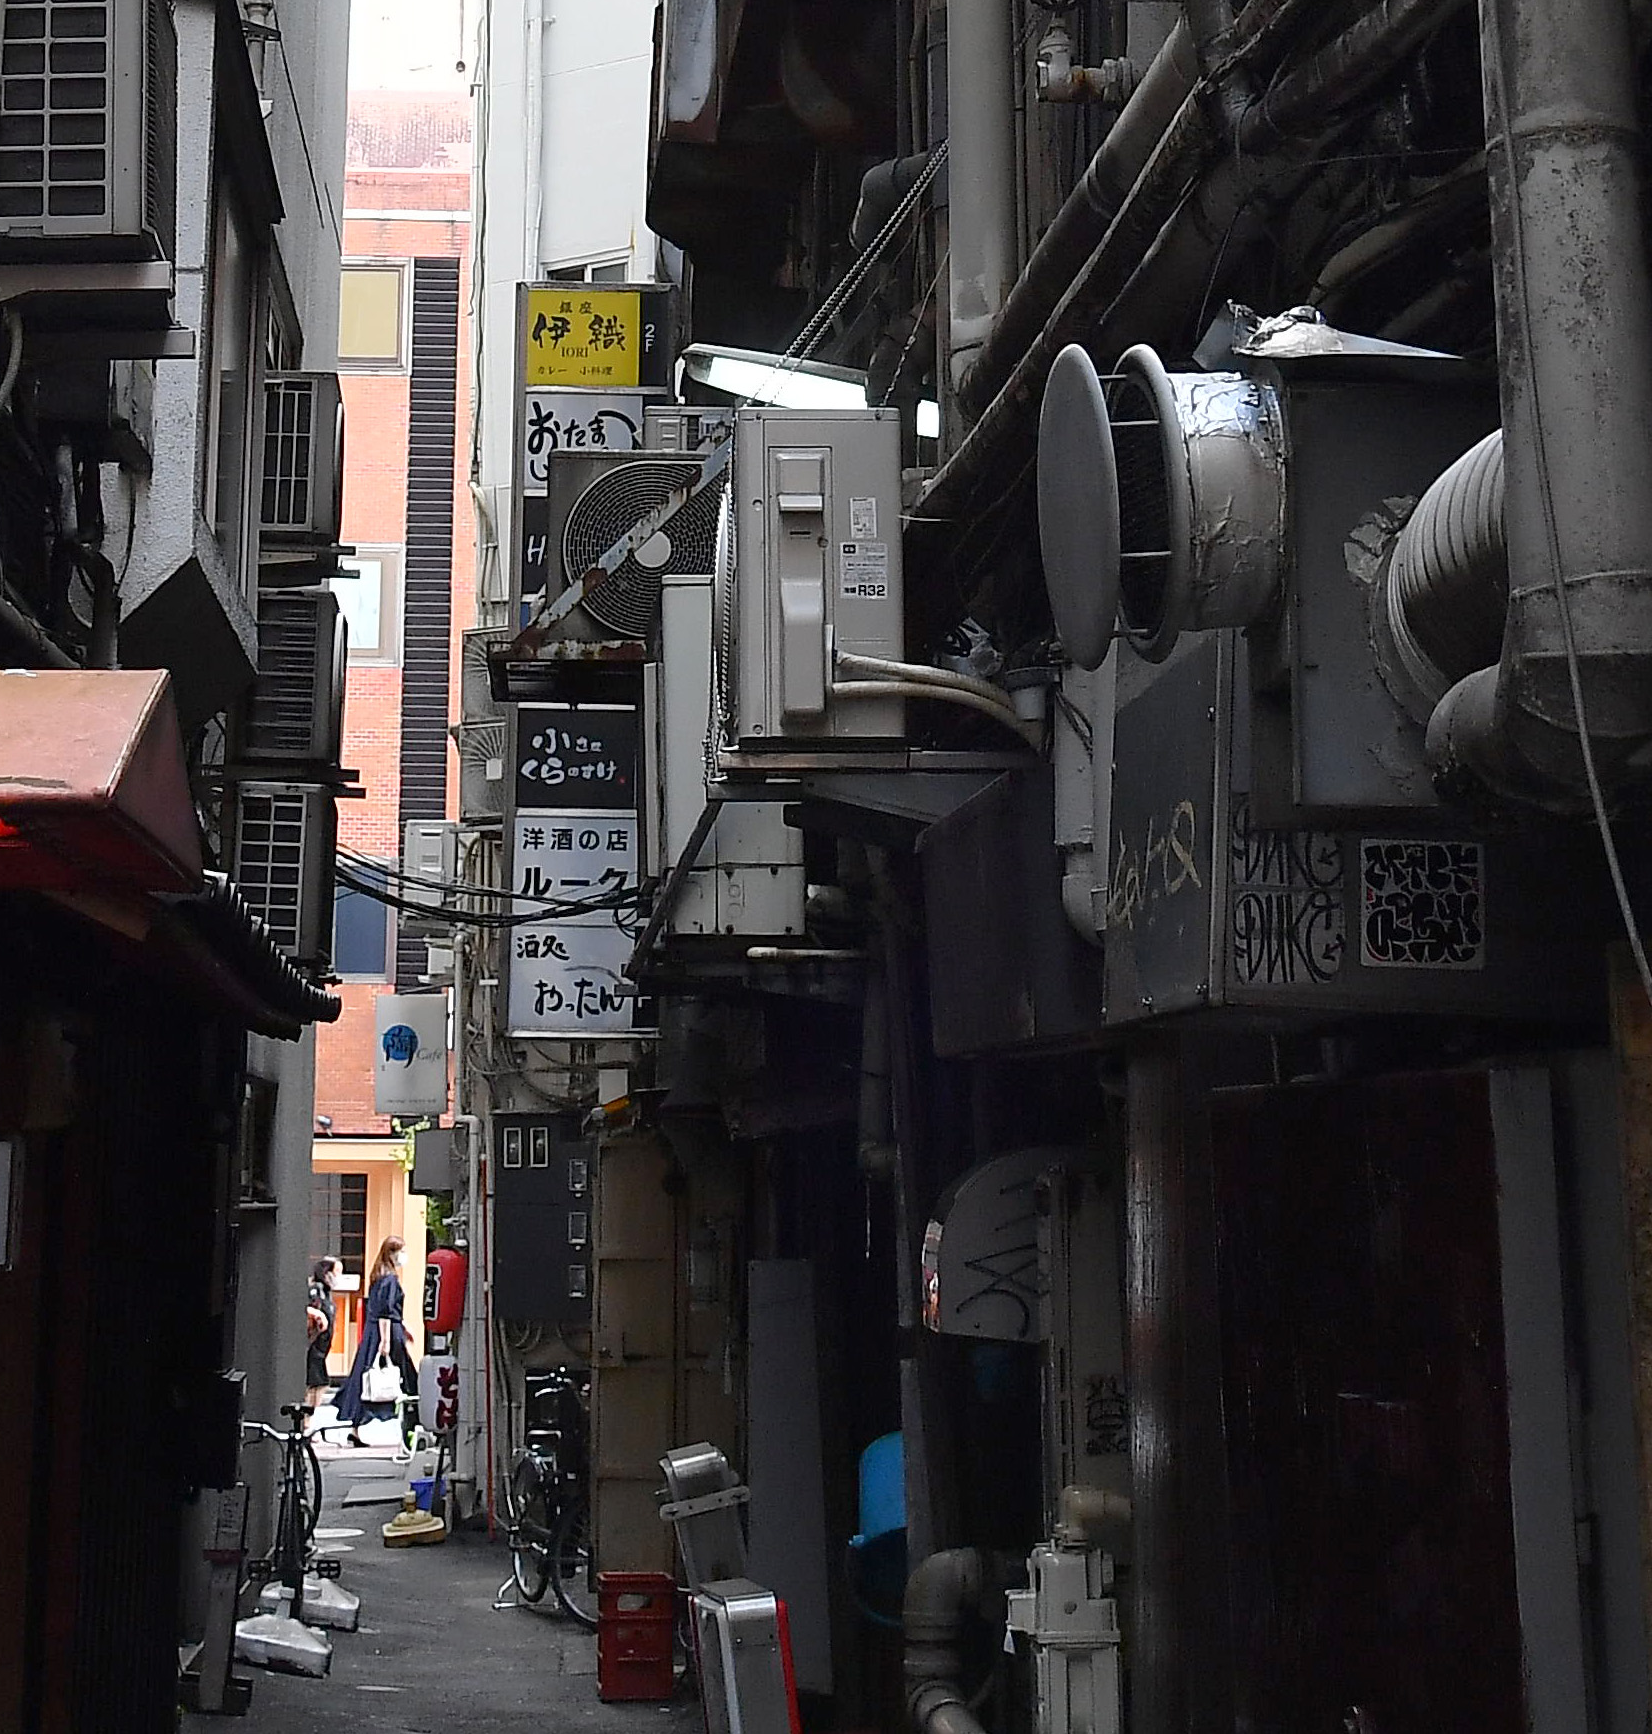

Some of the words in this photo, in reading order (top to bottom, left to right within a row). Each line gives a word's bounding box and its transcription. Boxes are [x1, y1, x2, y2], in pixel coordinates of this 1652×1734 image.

[559, 300, 593, 315] 銀座
[532, 312, 626, 351] 伊織
[644, 324, 655, 353] 2F
[560, 346, 589, 358] IORI
[858, 584, 886, 597] R32
[521, 757, 617, 785] くらのすけ
[522, 827, 628, 852] 洋酒の店
[516, 934, 571, 961] 酒処
